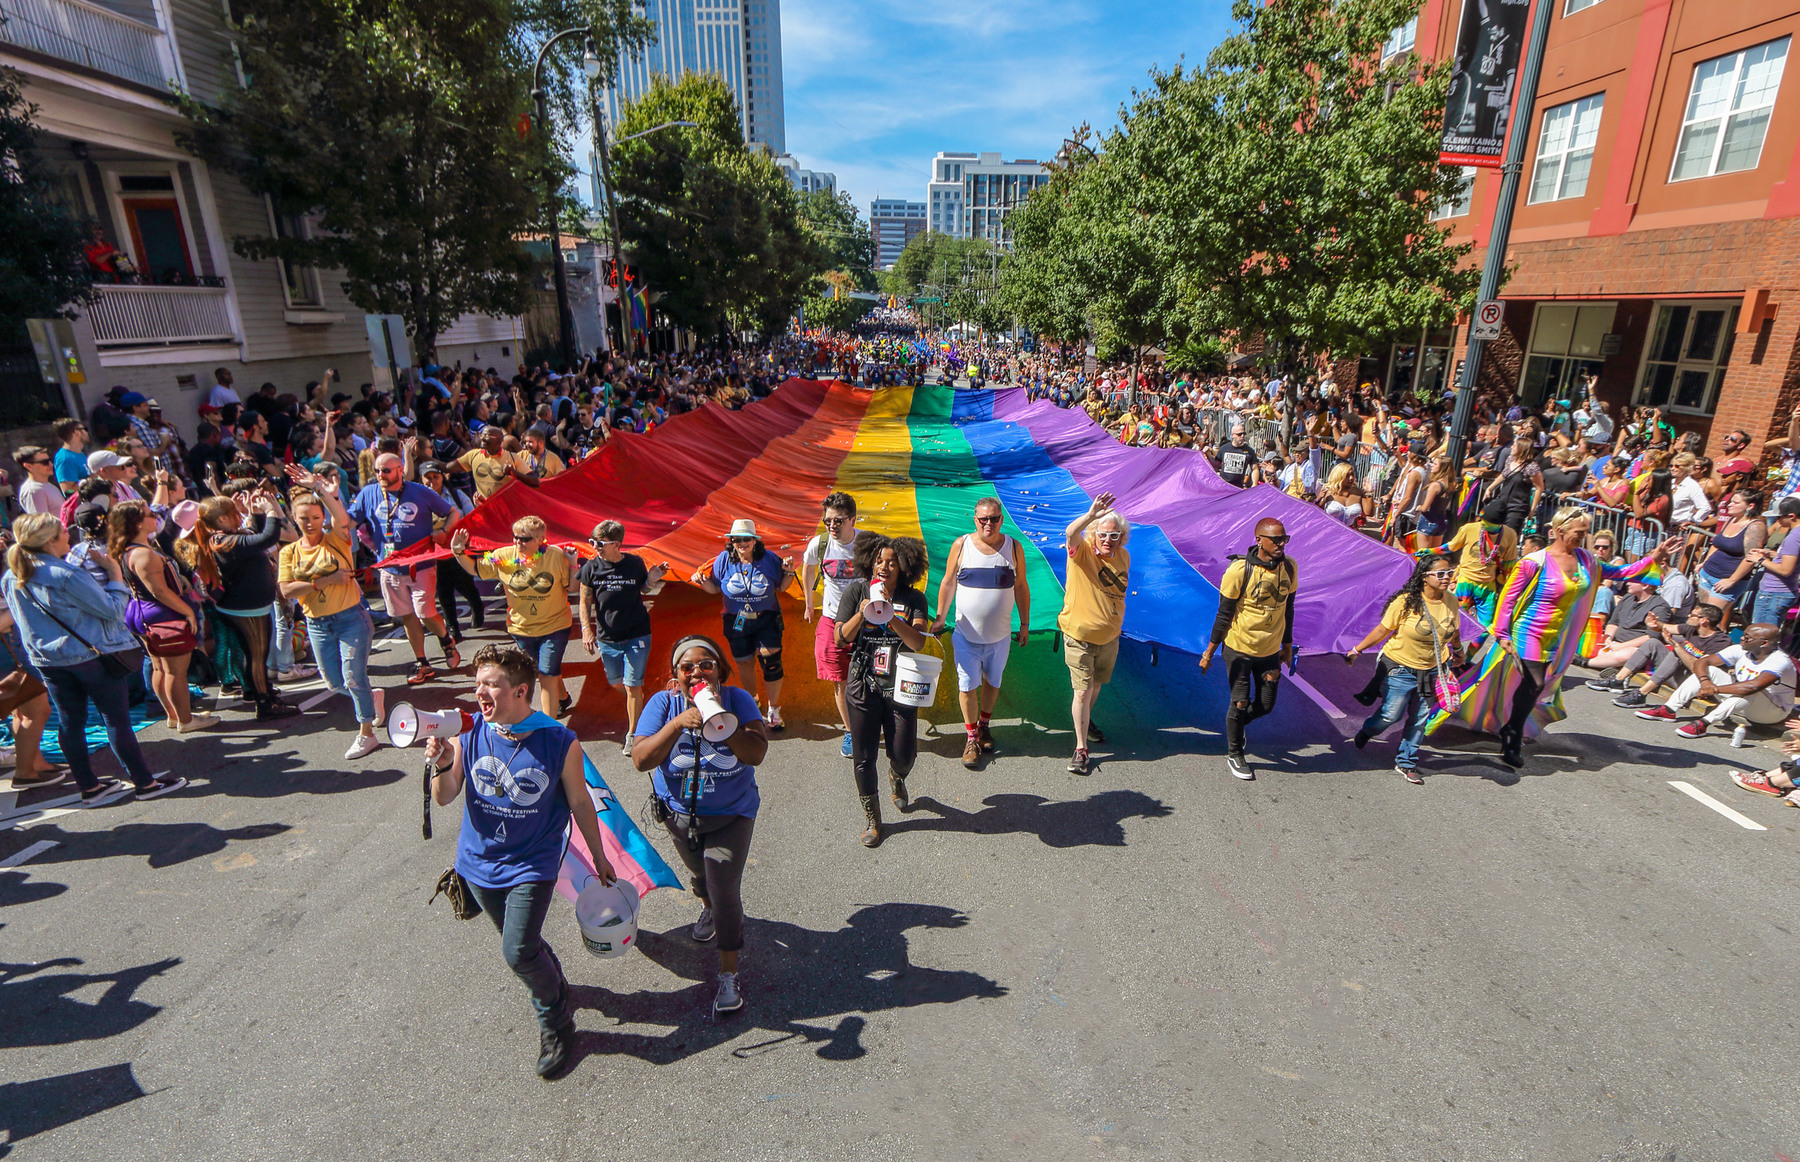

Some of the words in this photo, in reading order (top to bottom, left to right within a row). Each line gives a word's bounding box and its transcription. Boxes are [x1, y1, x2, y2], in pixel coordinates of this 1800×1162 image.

[1442, 136, 1471, 145] GLENN
[1471, 137, 1497, 147] KAINO
[1496, 139, 1503, 147] &
[1441, 144, 1475, 153] TOMMIE
[1475, 146, 1502, 155] SMITH
[1025, 333, 1034, 344] H
[902, 681, 928, 690] ATLANTA
[906, 687, 923, 695] PRIDE
[473, 799, 496, 810] ATANTA
